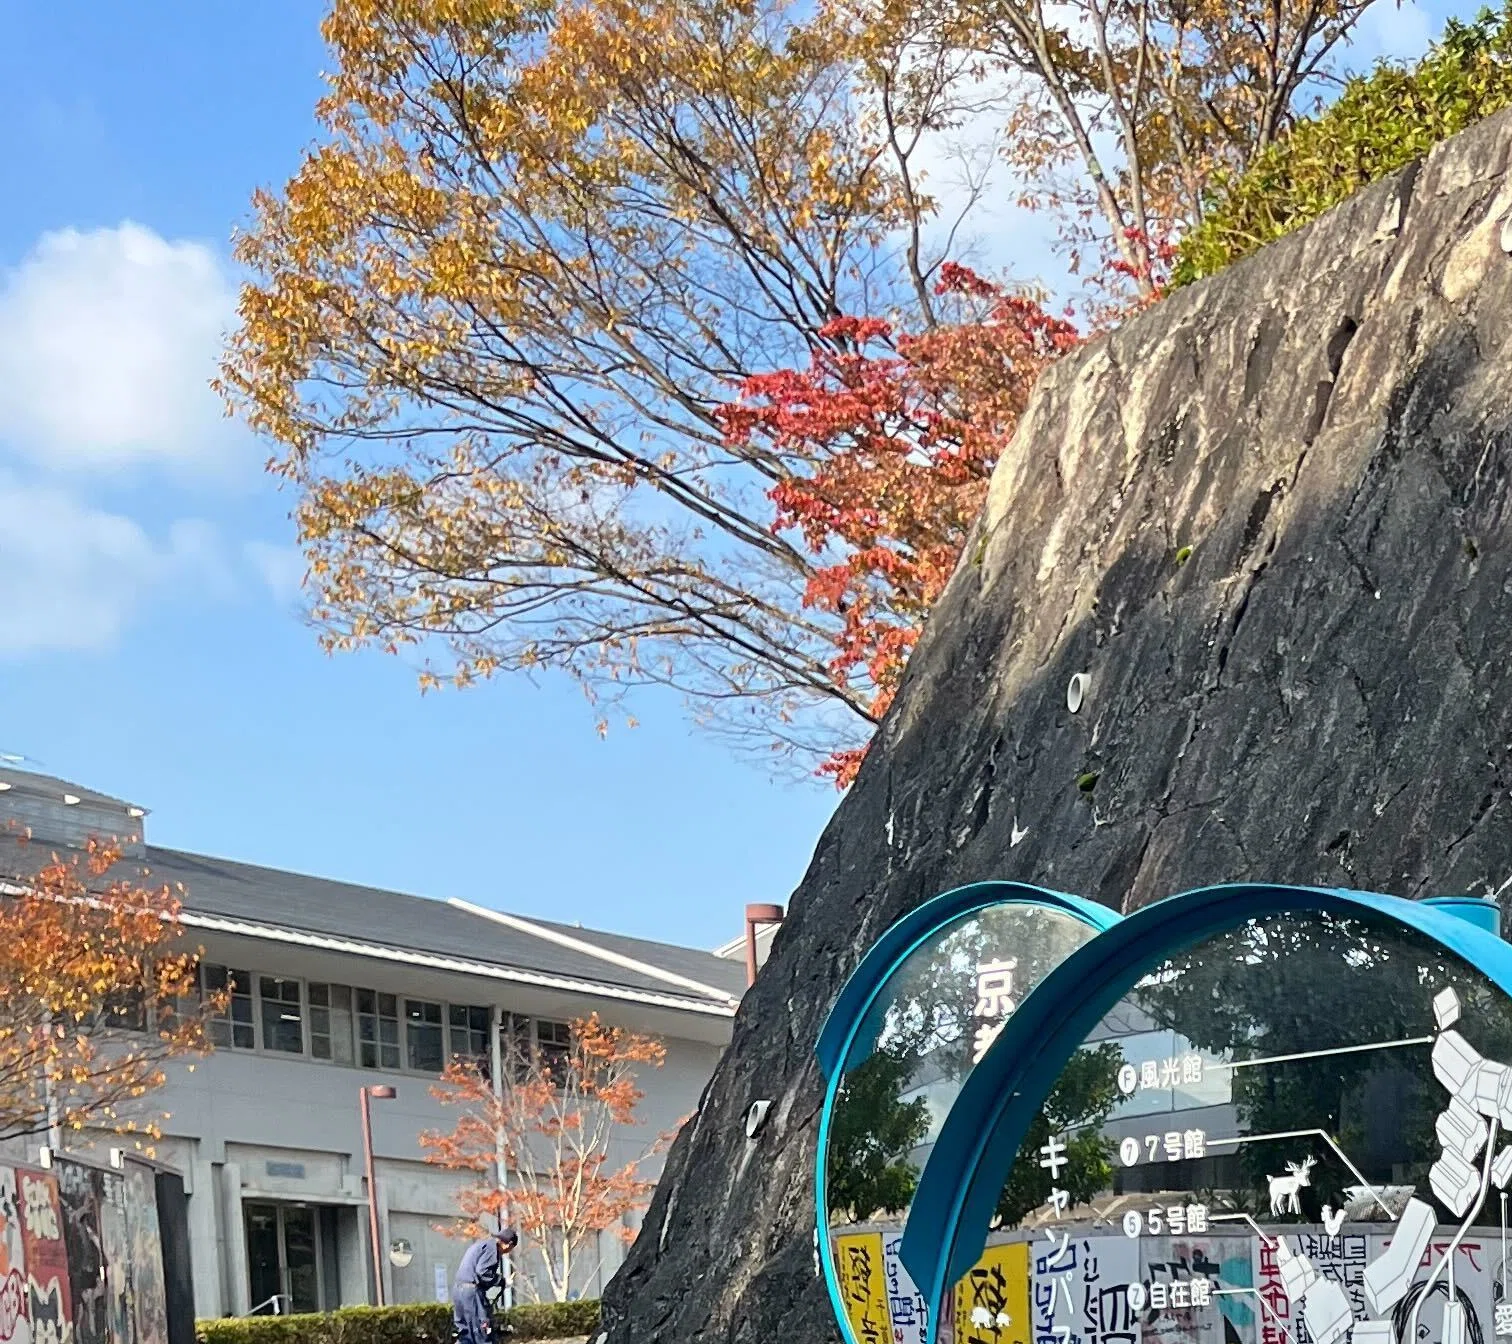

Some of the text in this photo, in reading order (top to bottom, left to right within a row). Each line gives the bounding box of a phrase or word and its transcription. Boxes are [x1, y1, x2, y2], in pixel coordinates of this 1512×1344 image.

[1140, 1056, 1203, 1090] 風光館
[1145, 1129, 1207, 1161] 7号館
[1148, 1204, 1209, 1235] 5号館
[1150, 1278, 1211, 1308] 自在館
